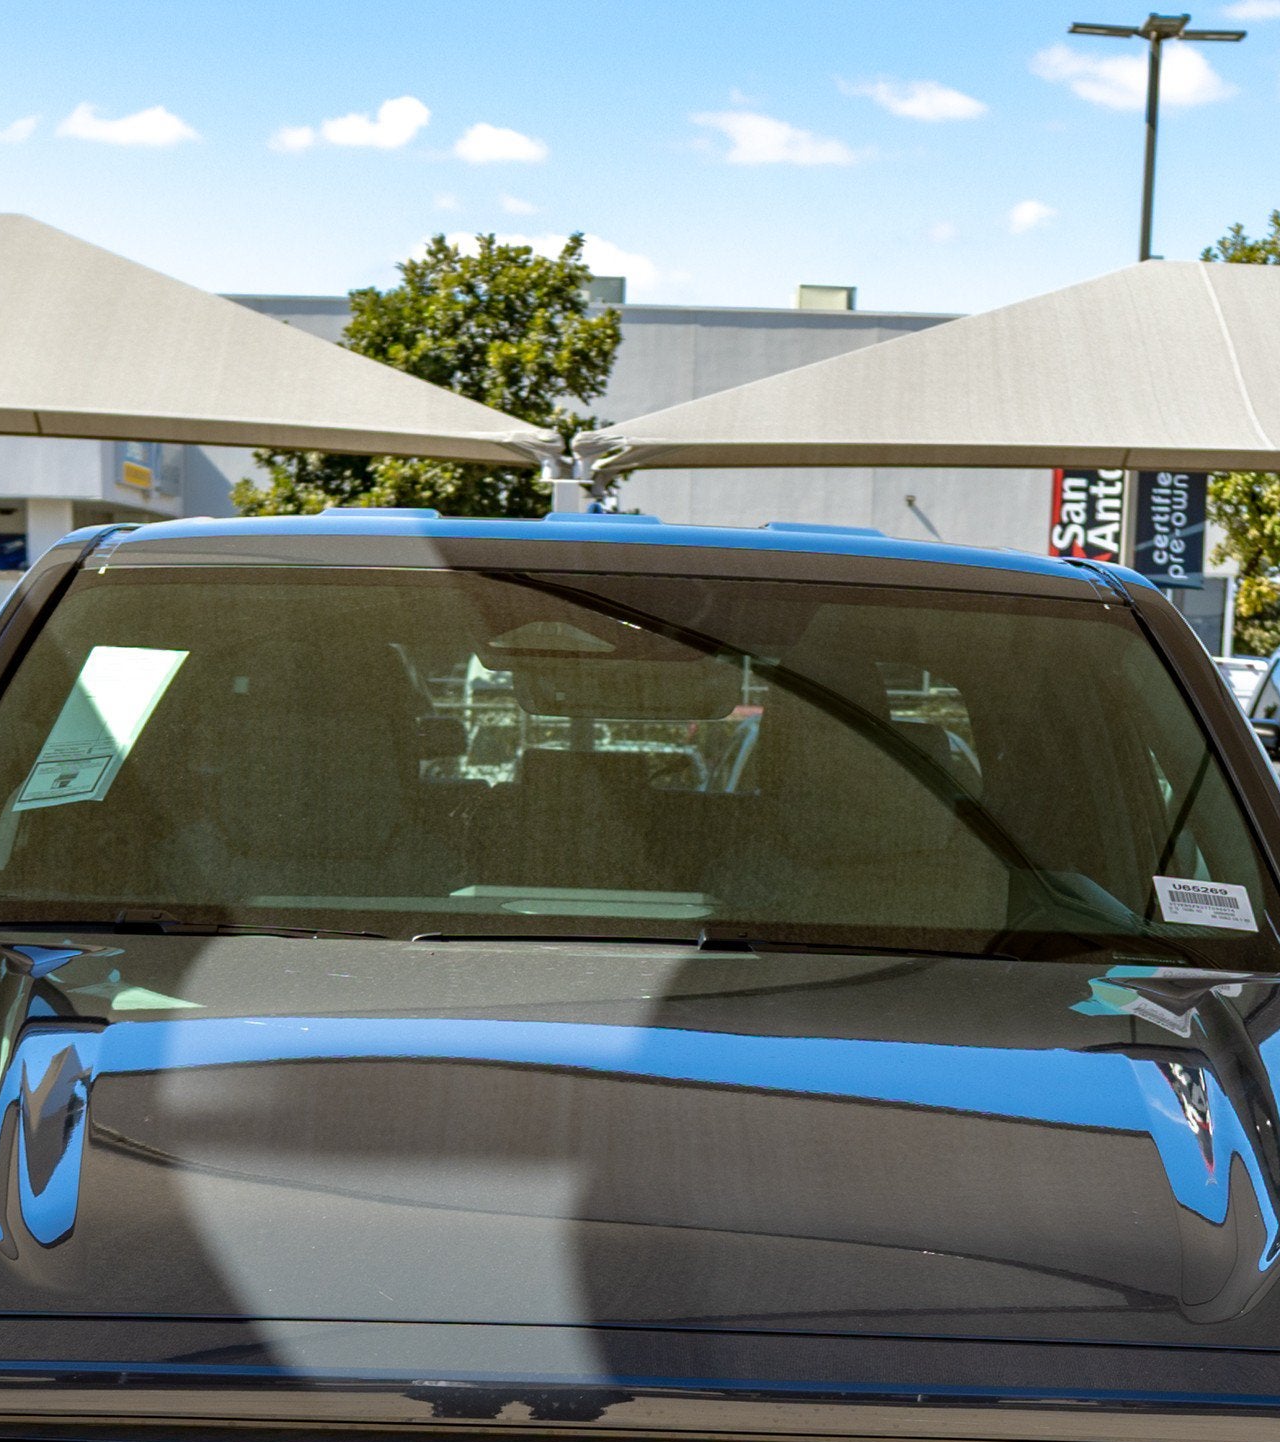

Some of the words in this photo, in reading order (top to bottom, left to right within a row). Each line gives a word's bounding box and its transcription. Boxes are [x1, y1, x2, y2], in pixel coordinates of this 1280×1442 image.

[1052, 477, 1088, 549] San
[1151, 472, 1172, 565] certifie
[1168, 474, 1189, 579] pre-own
